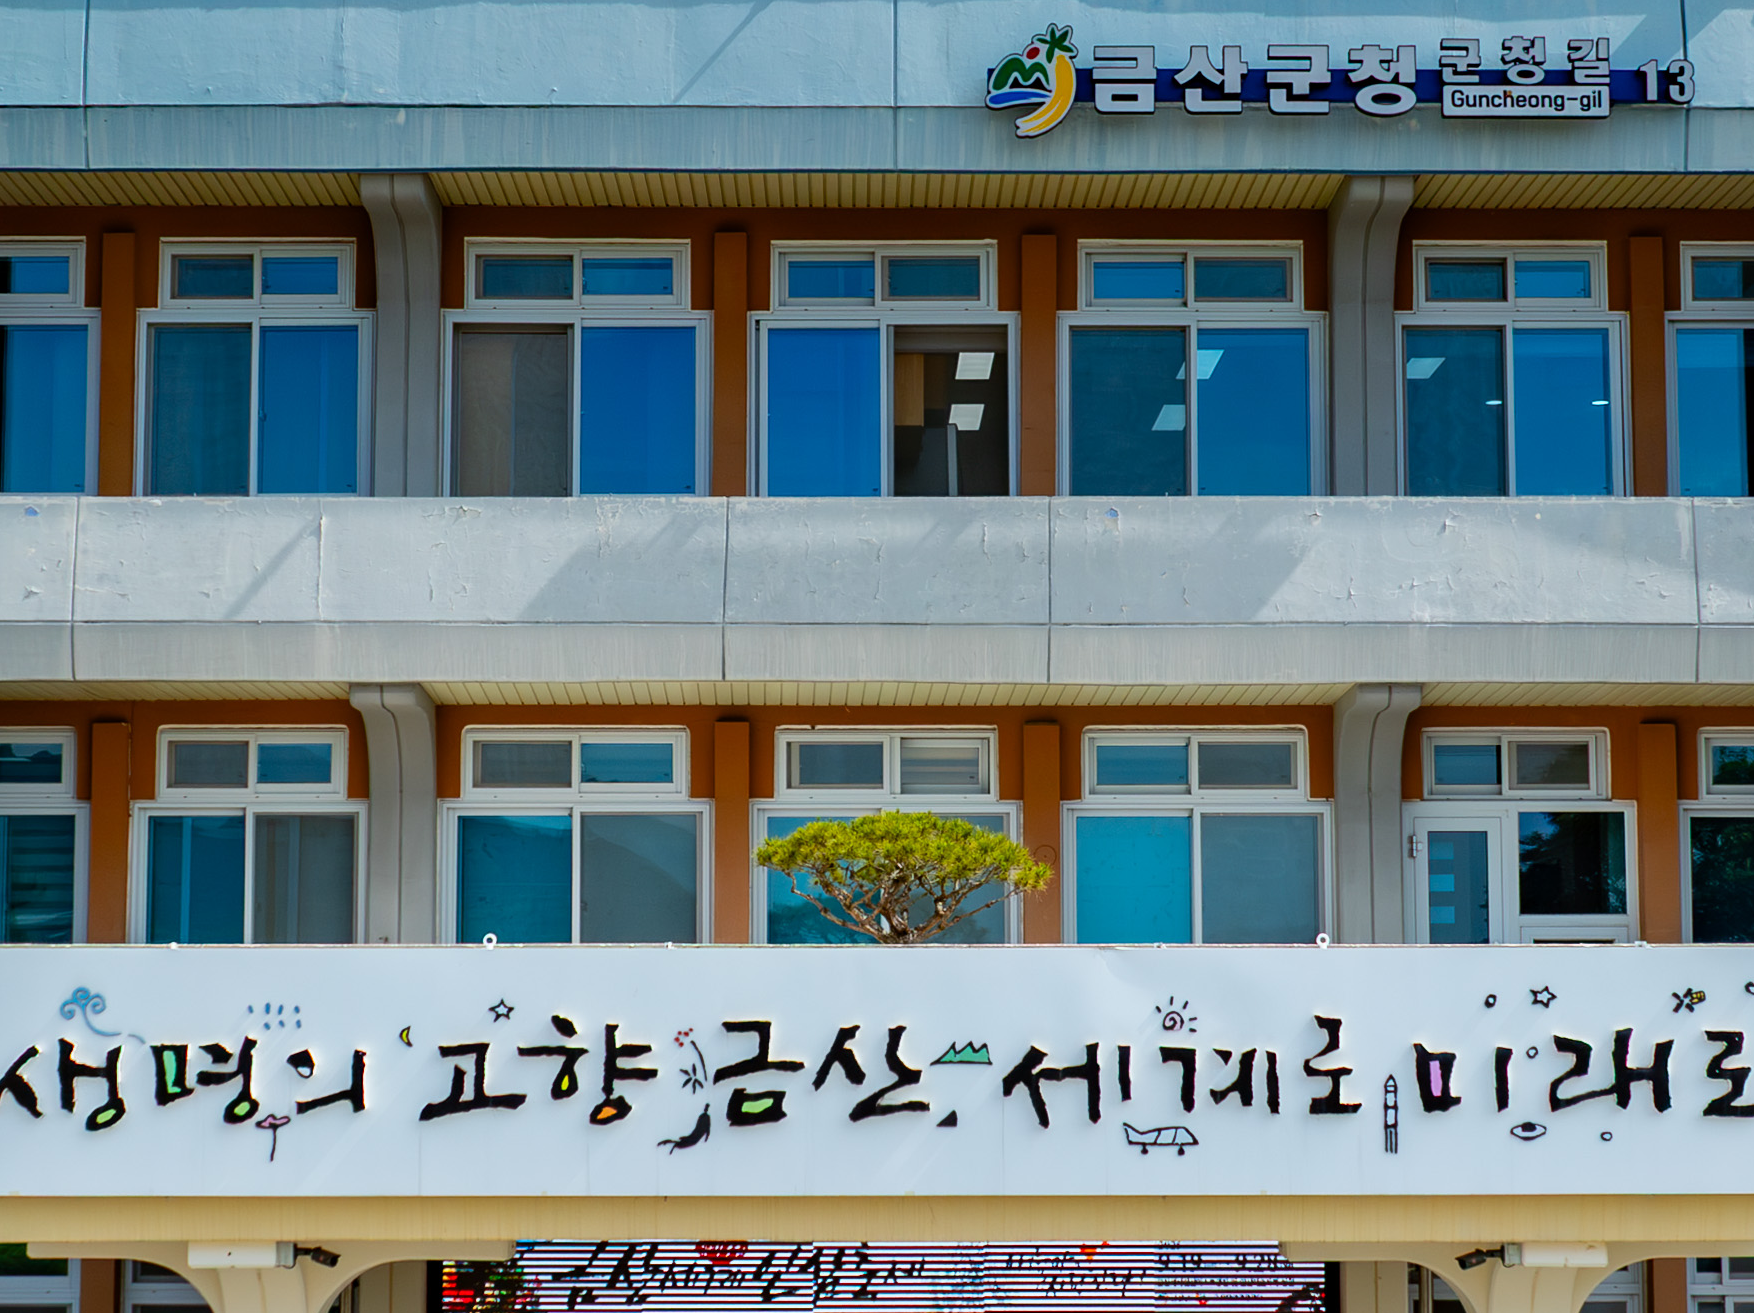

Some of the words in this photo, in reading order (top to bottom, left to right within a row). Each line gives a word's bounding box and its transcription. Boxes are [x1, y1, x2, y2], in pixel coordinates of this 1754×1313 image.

[1092, 43, 1418, 117] 금산군청
[1439, 36, 1611, 86] 군청길
[1638, 58, 1695, 104] 13
[1450, 90, 1603, 113] Guncheong-gil
[419, 1015, 659, 1126] 고향
[712, 1019, 930, 1128] 금산
[1003, 1015, 1362, 1129] 세계로
